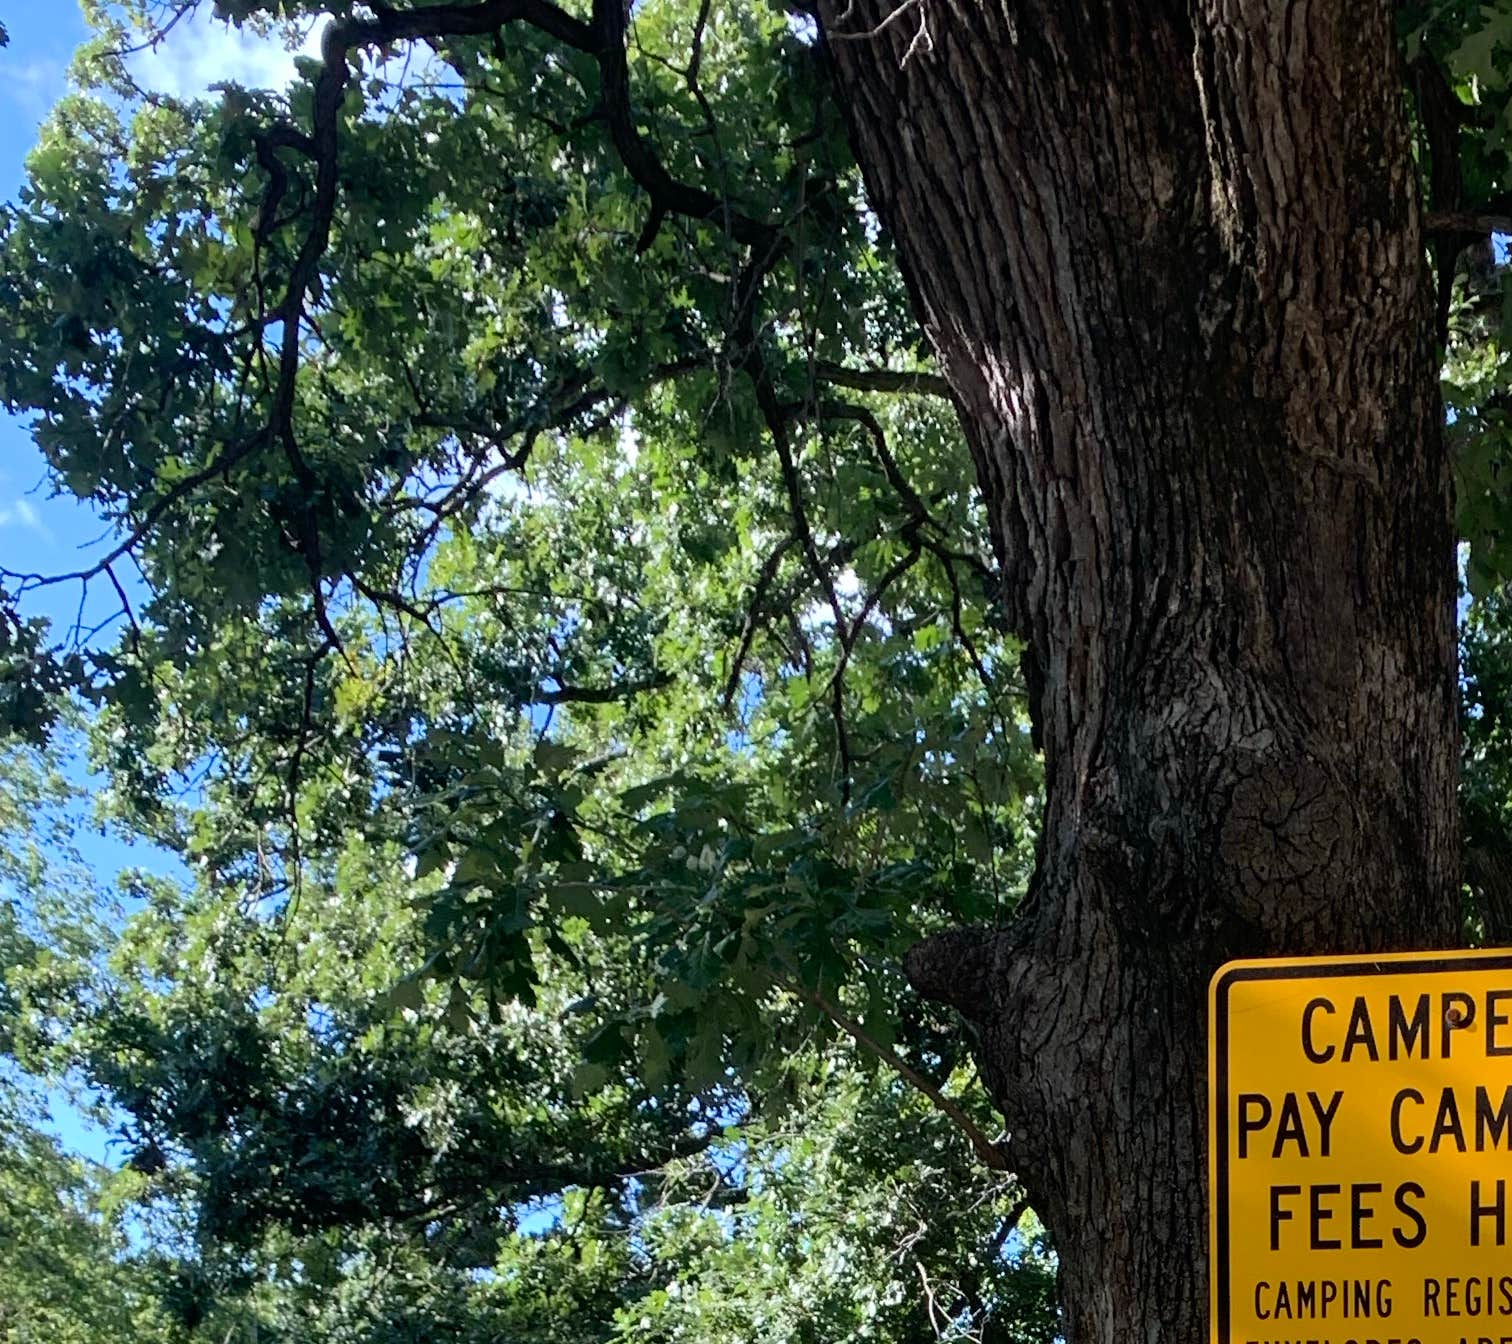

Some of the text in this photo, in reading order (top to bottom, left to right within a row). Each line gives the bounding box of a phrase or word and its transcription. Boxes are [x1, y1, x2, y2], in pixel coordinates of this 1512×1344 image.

[1238, 1091, 1344, 1158] PAY
[1270, 1182, 1427, 1250] FEES
[1255, 1279, 1393, 1319] CAMPING
